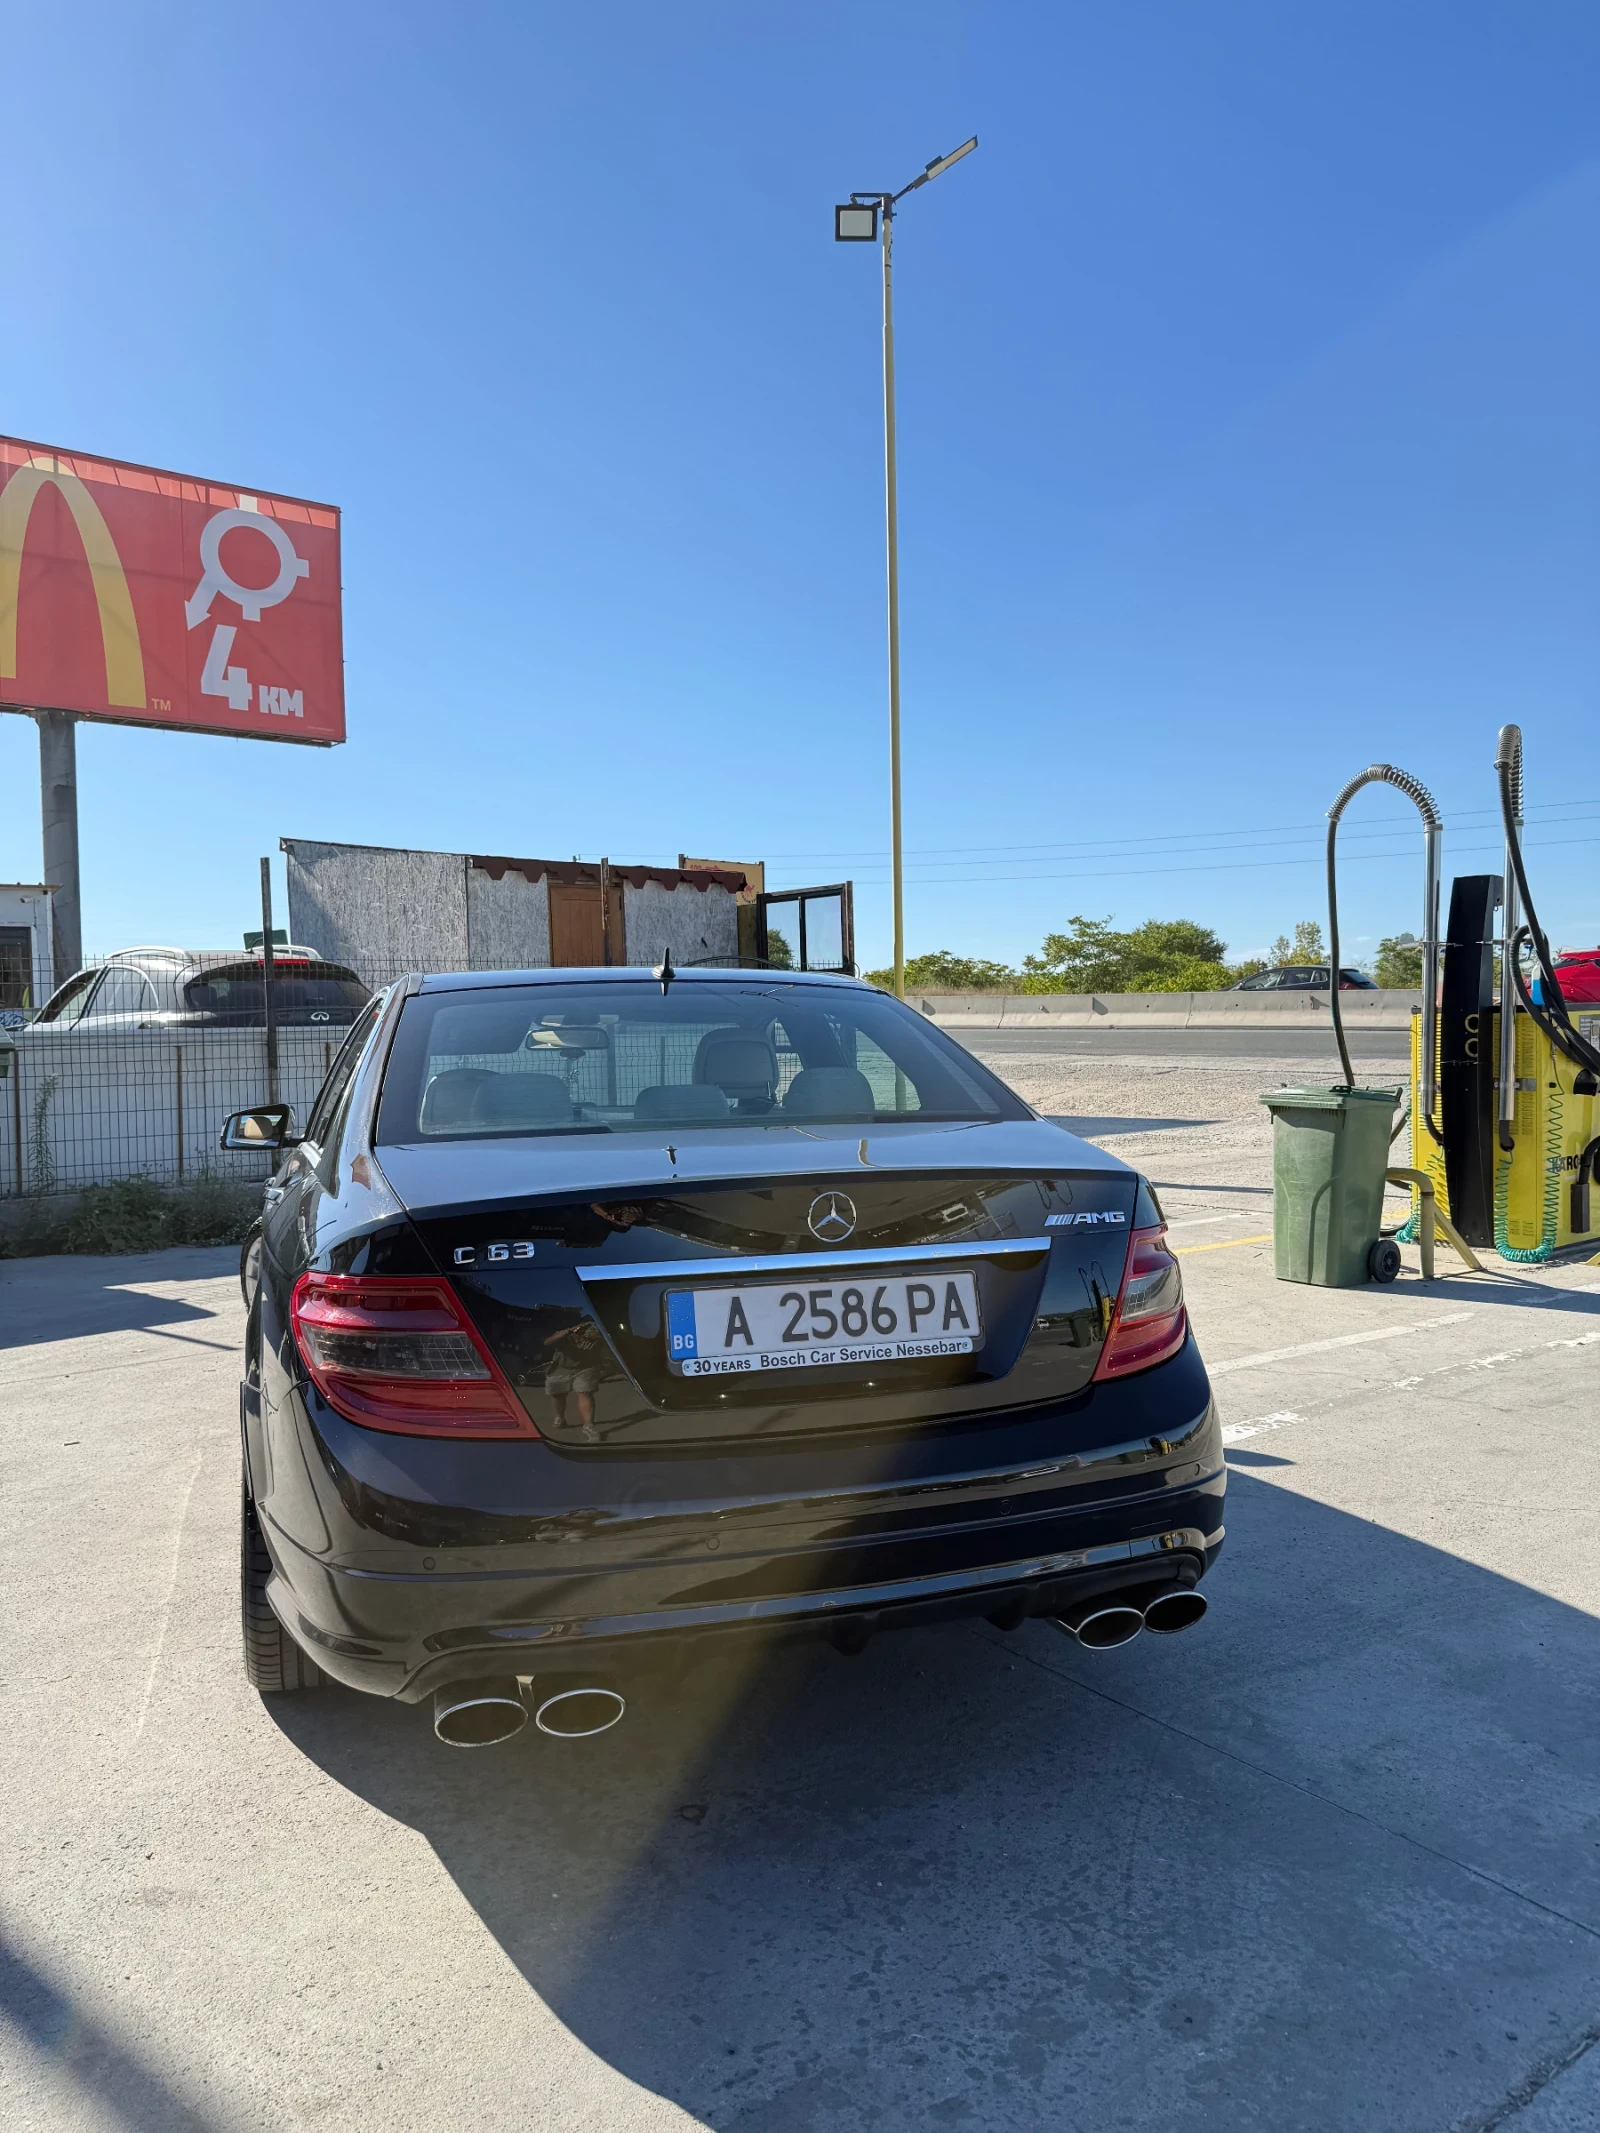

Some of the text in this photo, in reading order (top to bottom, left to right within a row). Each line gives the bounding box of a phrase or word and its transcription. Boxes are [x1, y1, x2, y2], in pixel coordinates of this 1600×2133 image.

[201, 624, 304, 718] 4 KM
[151, 698, 171, 712] TM
[1073, 1211, 1125, 1225] AMG
[454, 1242, 535, 1264] C 63
[724, 1281, 970, 1347] A 2586 PA
[673, 1334, 695, 1350] BG
[693, 1340, 962, 1374] 30 YEARS Bosch Car Service Nessebar
